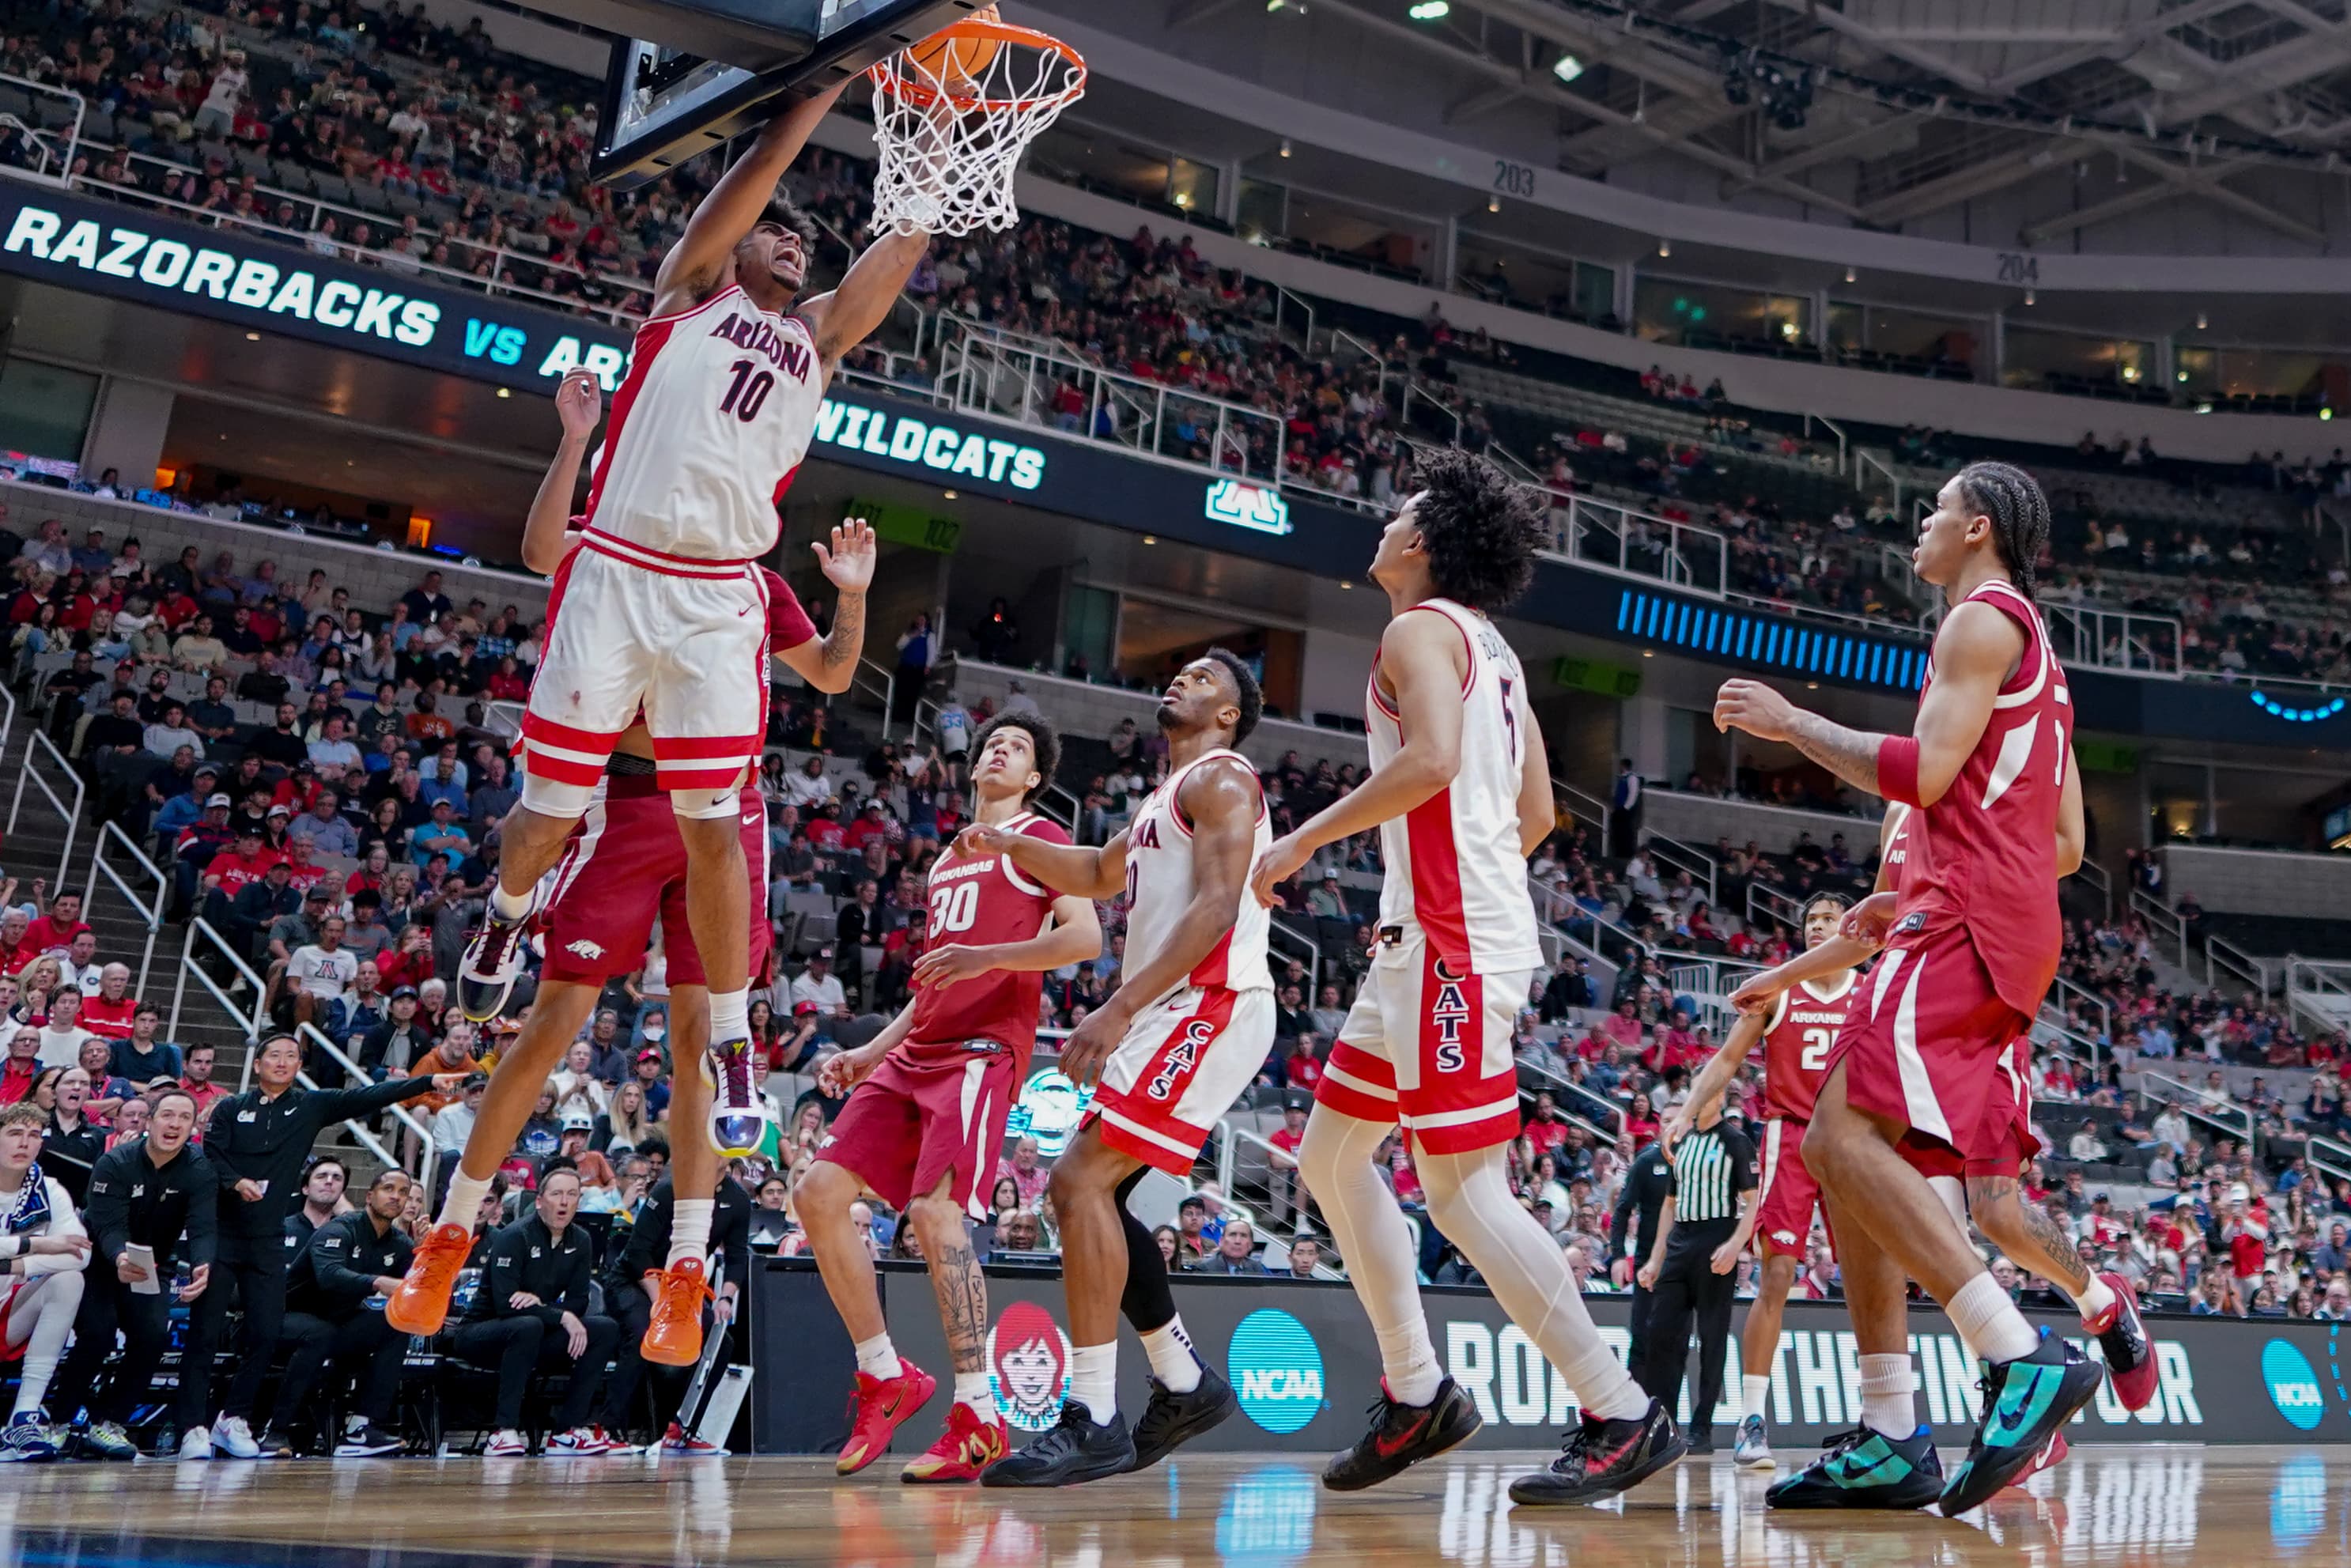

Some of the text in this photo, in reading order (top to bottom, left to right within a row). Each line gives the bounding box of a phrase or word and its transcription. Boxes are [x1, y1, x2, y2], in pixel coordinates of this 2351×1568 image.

[1493, 161, 1535, 198] 203
[1998, 253, 2039, 285] 204
[3, 206, 441, 346] RAZORBACKS
[463, 318, 527, 366] VS
[813, 399, 1046, 489] WILDCATS
[709, 312, 811, 387] ARIZONA
[718, 360, 775, 423] 10
[1499, 675, 1516, 768] 5
[933, 859, 995, 884] ARKANSAS
[1888, 849, 1907, 864] AR
[929, 880, 980, 939] 30
[1789, 1012, 1847, 1026] ARKANS
[1147, 1019, 1215, 1101] CATS
[1241, 1369, 2323, 1406] NCAA NCAA
